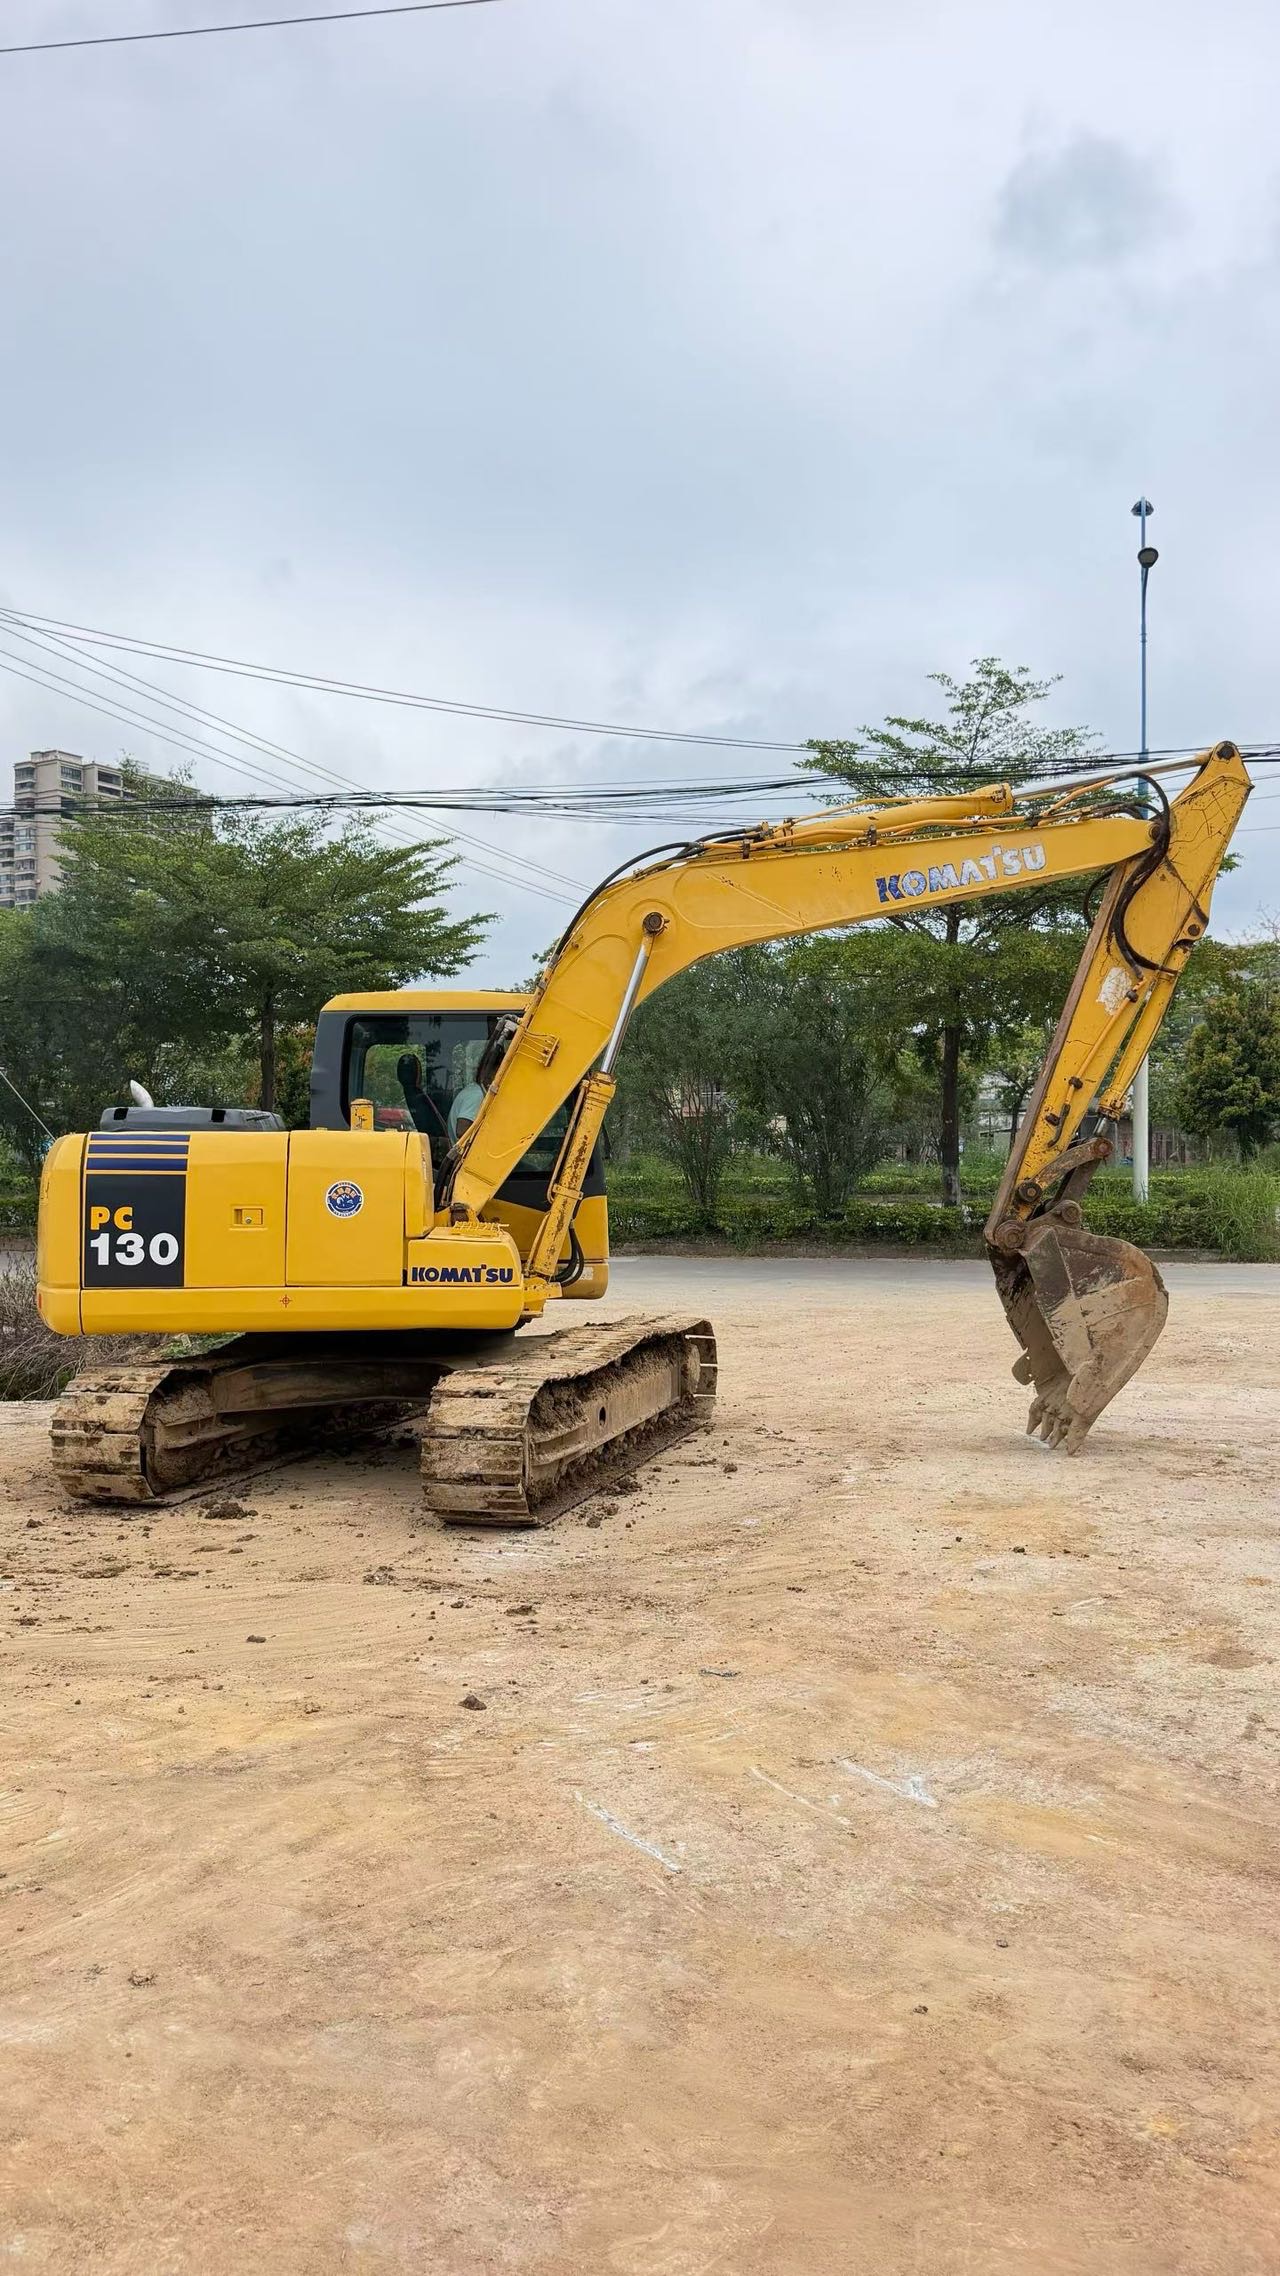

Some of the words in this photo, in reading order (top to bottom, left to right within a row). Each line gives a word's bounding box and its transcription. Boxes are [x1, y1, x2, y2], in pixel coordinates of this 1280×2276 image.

[876, 844, 1046, 903] KOMATSU
[90, 1206, 133, 1230] PC
[90, 1232, 179, 1266] 130
[411, 1264, 513, 1282] KOMATSU
